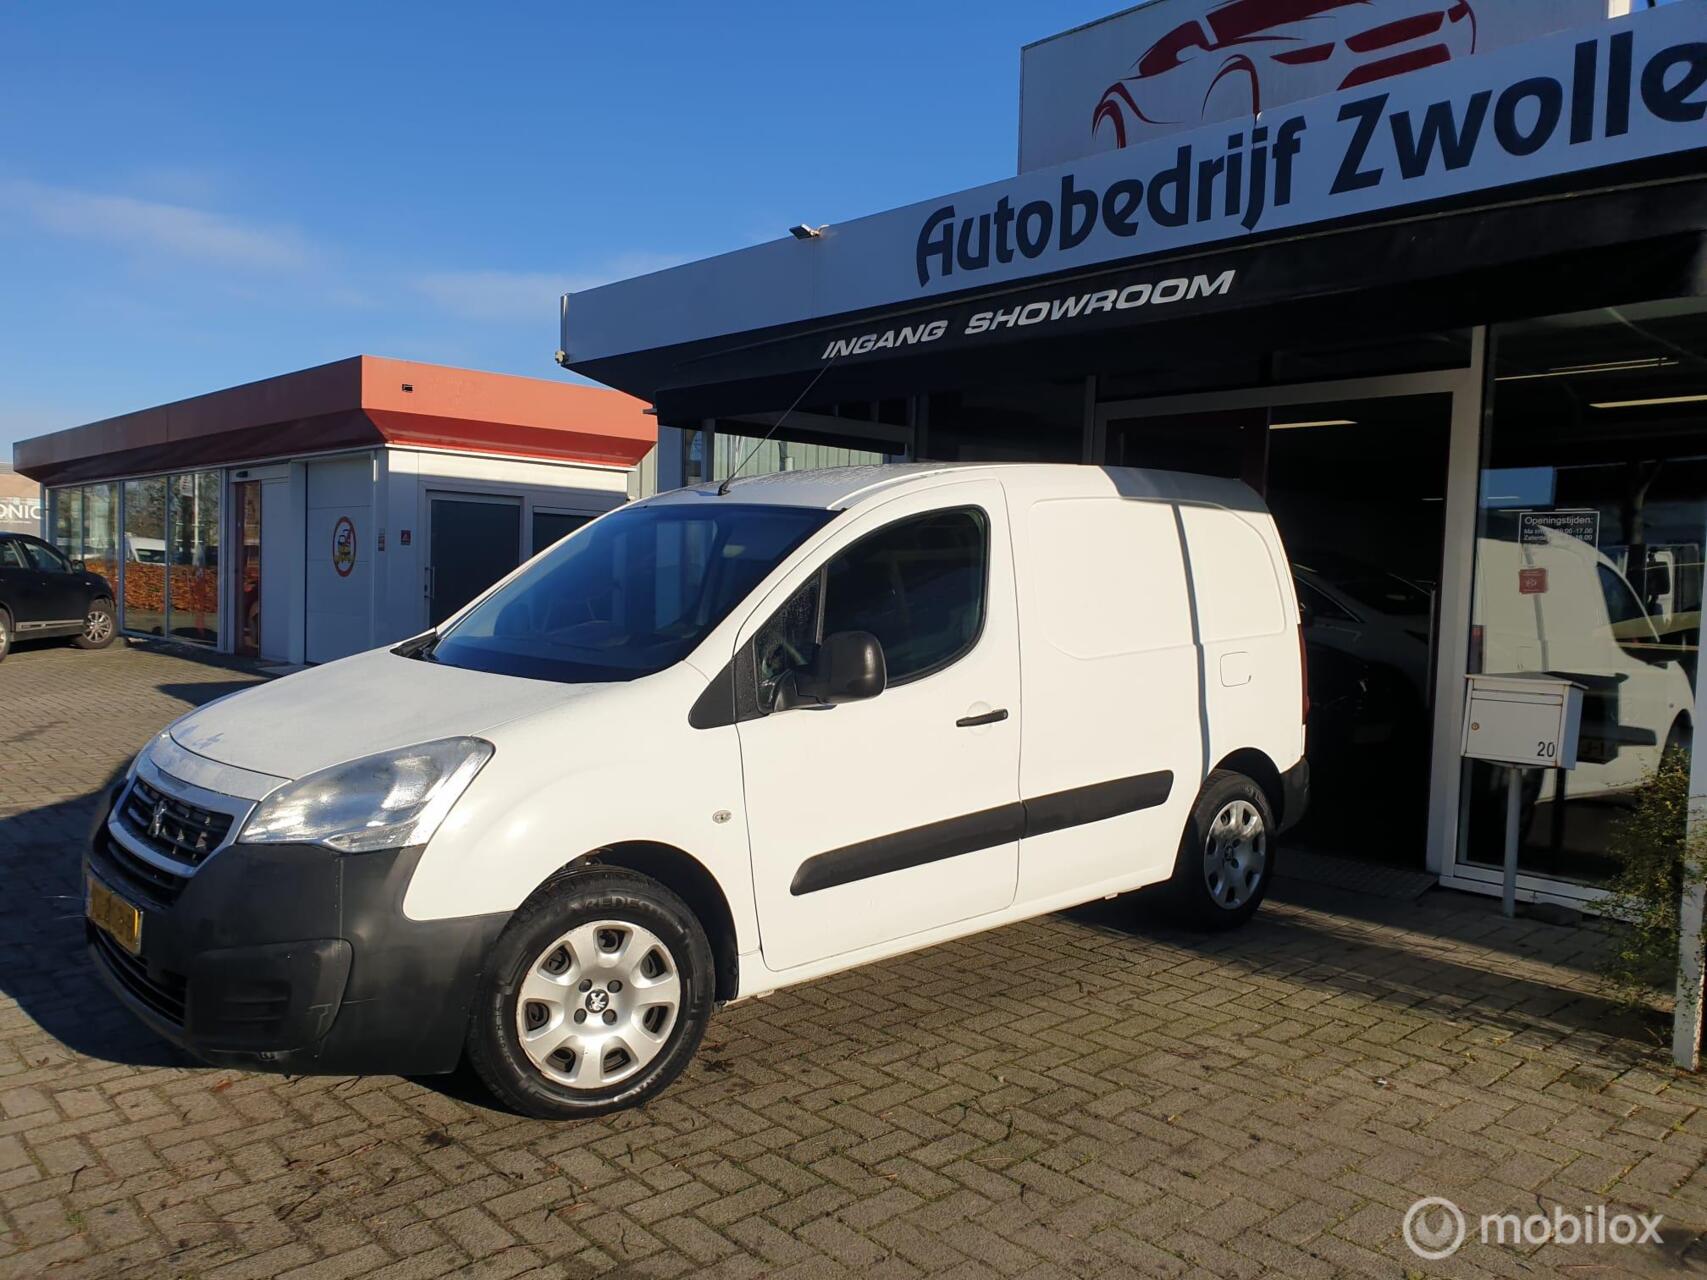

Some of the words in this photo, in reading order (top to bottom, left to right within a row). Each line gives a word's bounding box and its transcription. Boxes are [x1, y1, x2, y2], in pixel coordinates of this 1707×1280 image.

[916, 116, 1307, 288] Autobedrijf
[1329, 31, 1707, 195] Zwolle
[821, 320, 948, 360] INGANG
[964, 269, 1236, 335] SHOWROOM
[1537, 741, 1555, 758] 20
